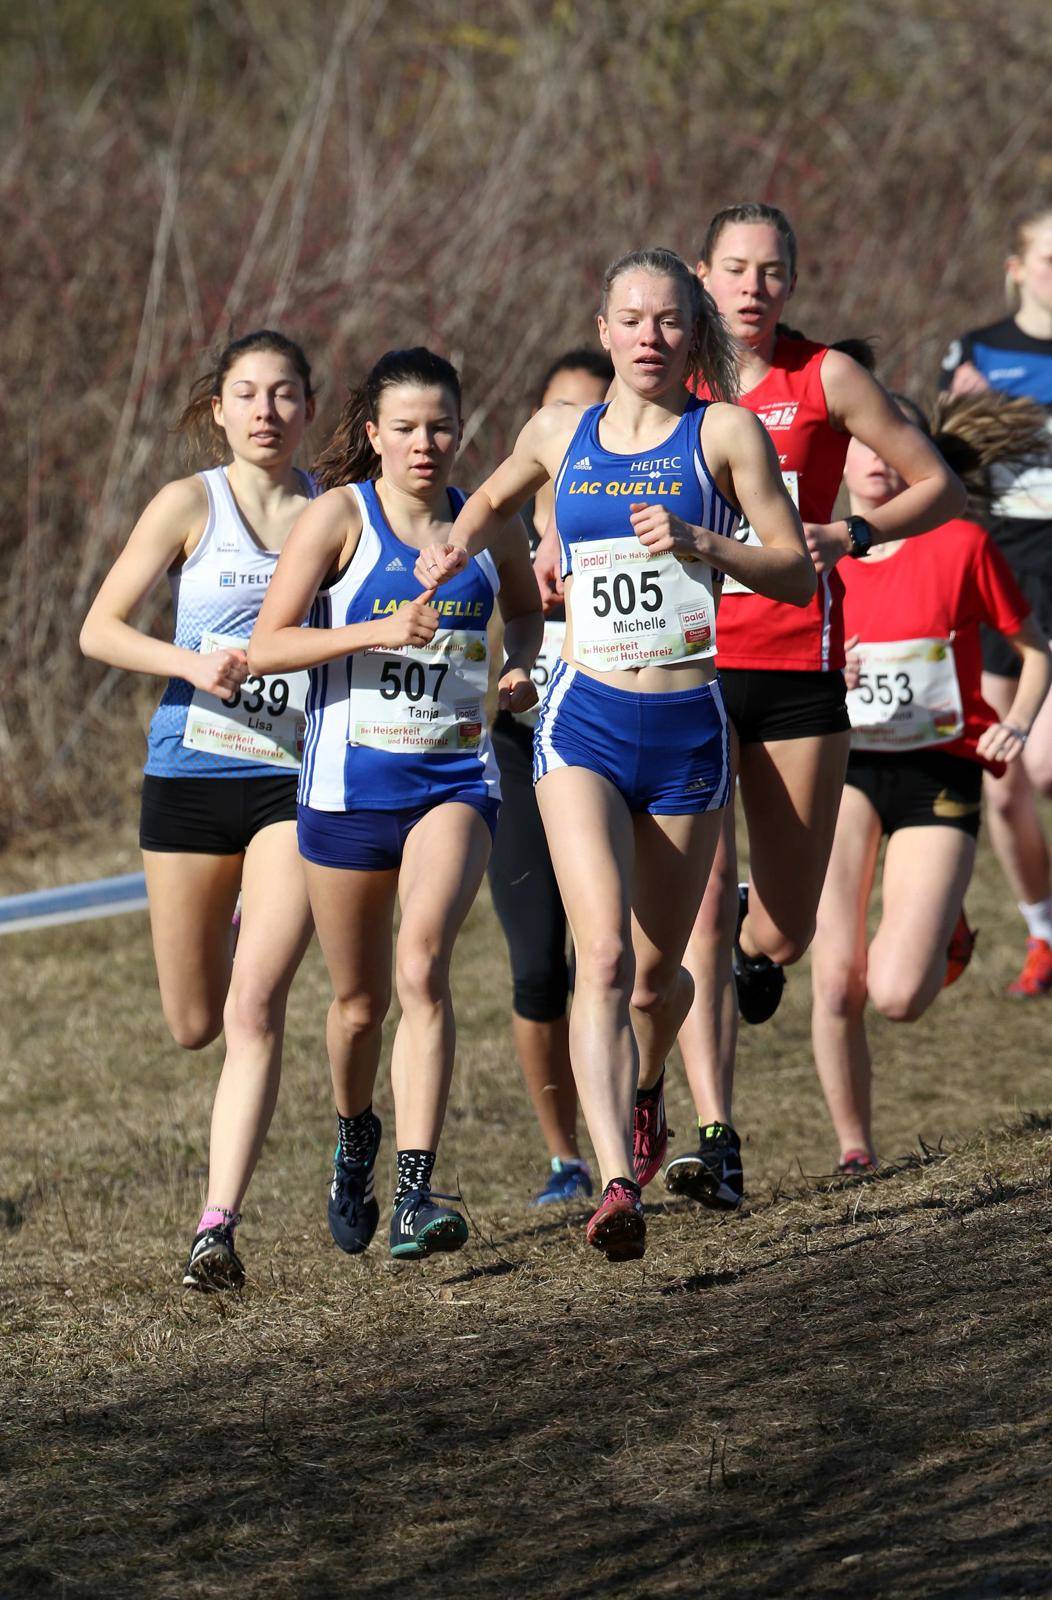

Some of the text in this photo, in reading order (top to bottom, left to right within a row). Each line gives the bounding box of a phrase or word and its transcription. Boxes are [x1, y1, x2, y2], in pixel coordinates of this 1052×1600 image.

[630, 457, 682, 471] HEITEC
[568, 481, 683, 496] LAC QUELLE
[580, 553, 609, 568] ipalat
[239, 574, 273, 584] TELI
[592, 570, 663, 618] 505
[613, 617, 667, 635] Michelle
[593, 641, 639, 655] Heiserkeit
[620, 648, 673, 661] Hustenreiz
[379, 661, 449, 703] 507
[859, 672, 914, 706] 553
[408, 706, 439, 721] Tanja
[247, 717, 273, 732] Lisa
[373, 724, 420, 736] Heiserkeit
[208, 728, 255, 745] Heiserkeit
[402, 734, 449, 746] Hustenreiz
[235, 743, 284, 760] Hustenreiz
